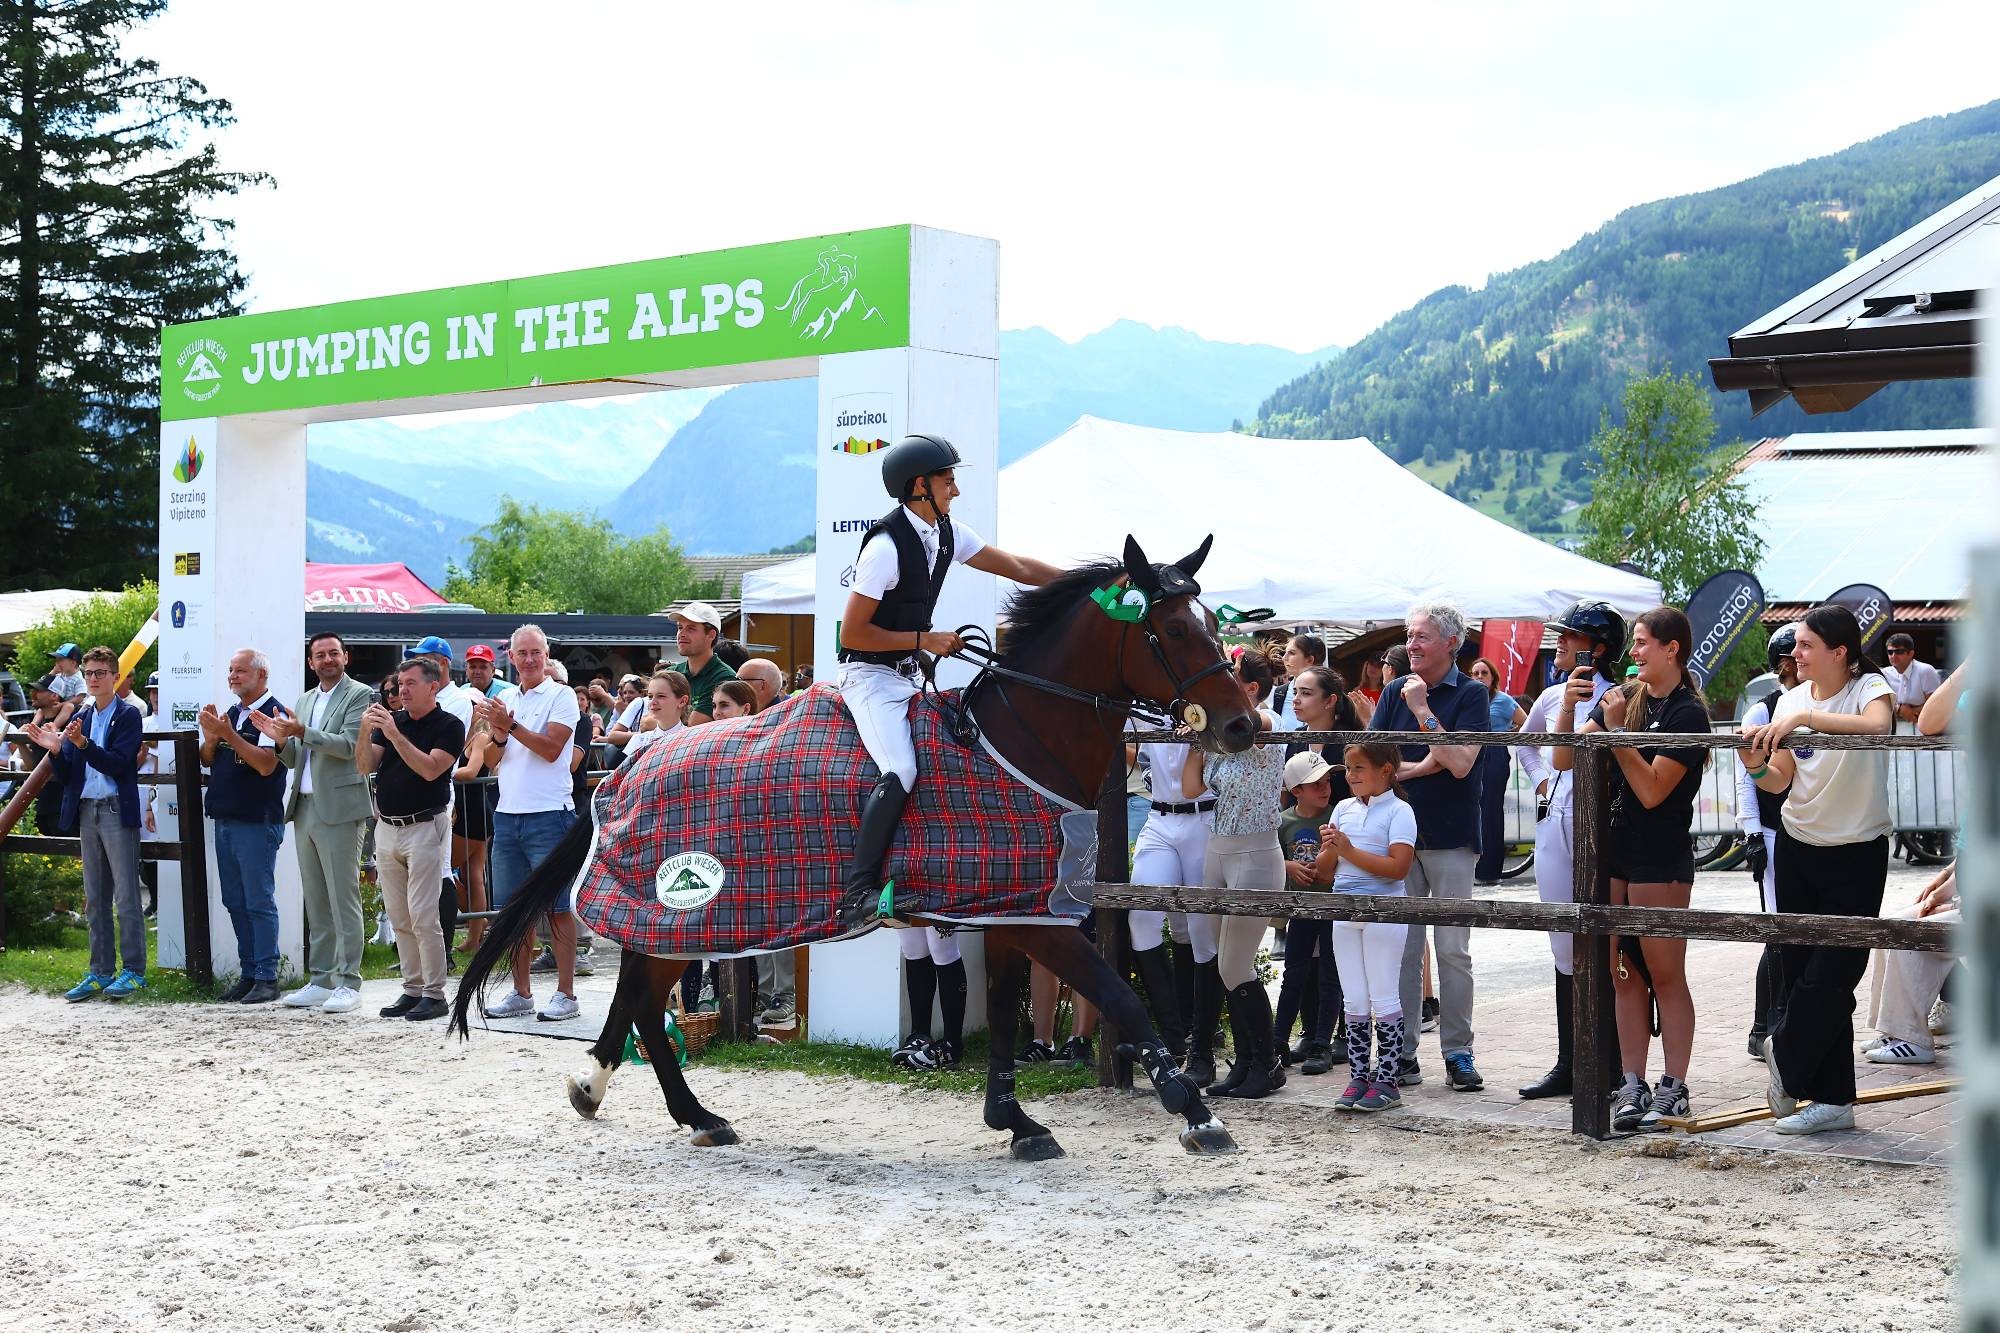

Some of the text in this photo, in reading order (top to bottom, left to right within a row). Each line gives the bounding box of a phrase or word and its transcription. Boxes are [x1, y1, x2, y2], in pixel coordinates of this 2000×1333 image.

[242, 278, 764, 384] JUMPING IN THE ALPS
[176, 338, 228, 368] REITCLUB WIESEN
[170, 489, 206, 504] Sterzing
[170, 507, 206, 522] Vipiteno
[832, 520, 879, 532] LEITNE
[1694, 586, 1753, 663] FOTOSHOP
[1706, 601, 1760, 670] www.fotoshopeventi.it
[171, 667, 202, 675] FEUERSTEIN
[174, 709, 198, 722] FORST
[658, 855, 721, 882] REITCLUB WIESEN
